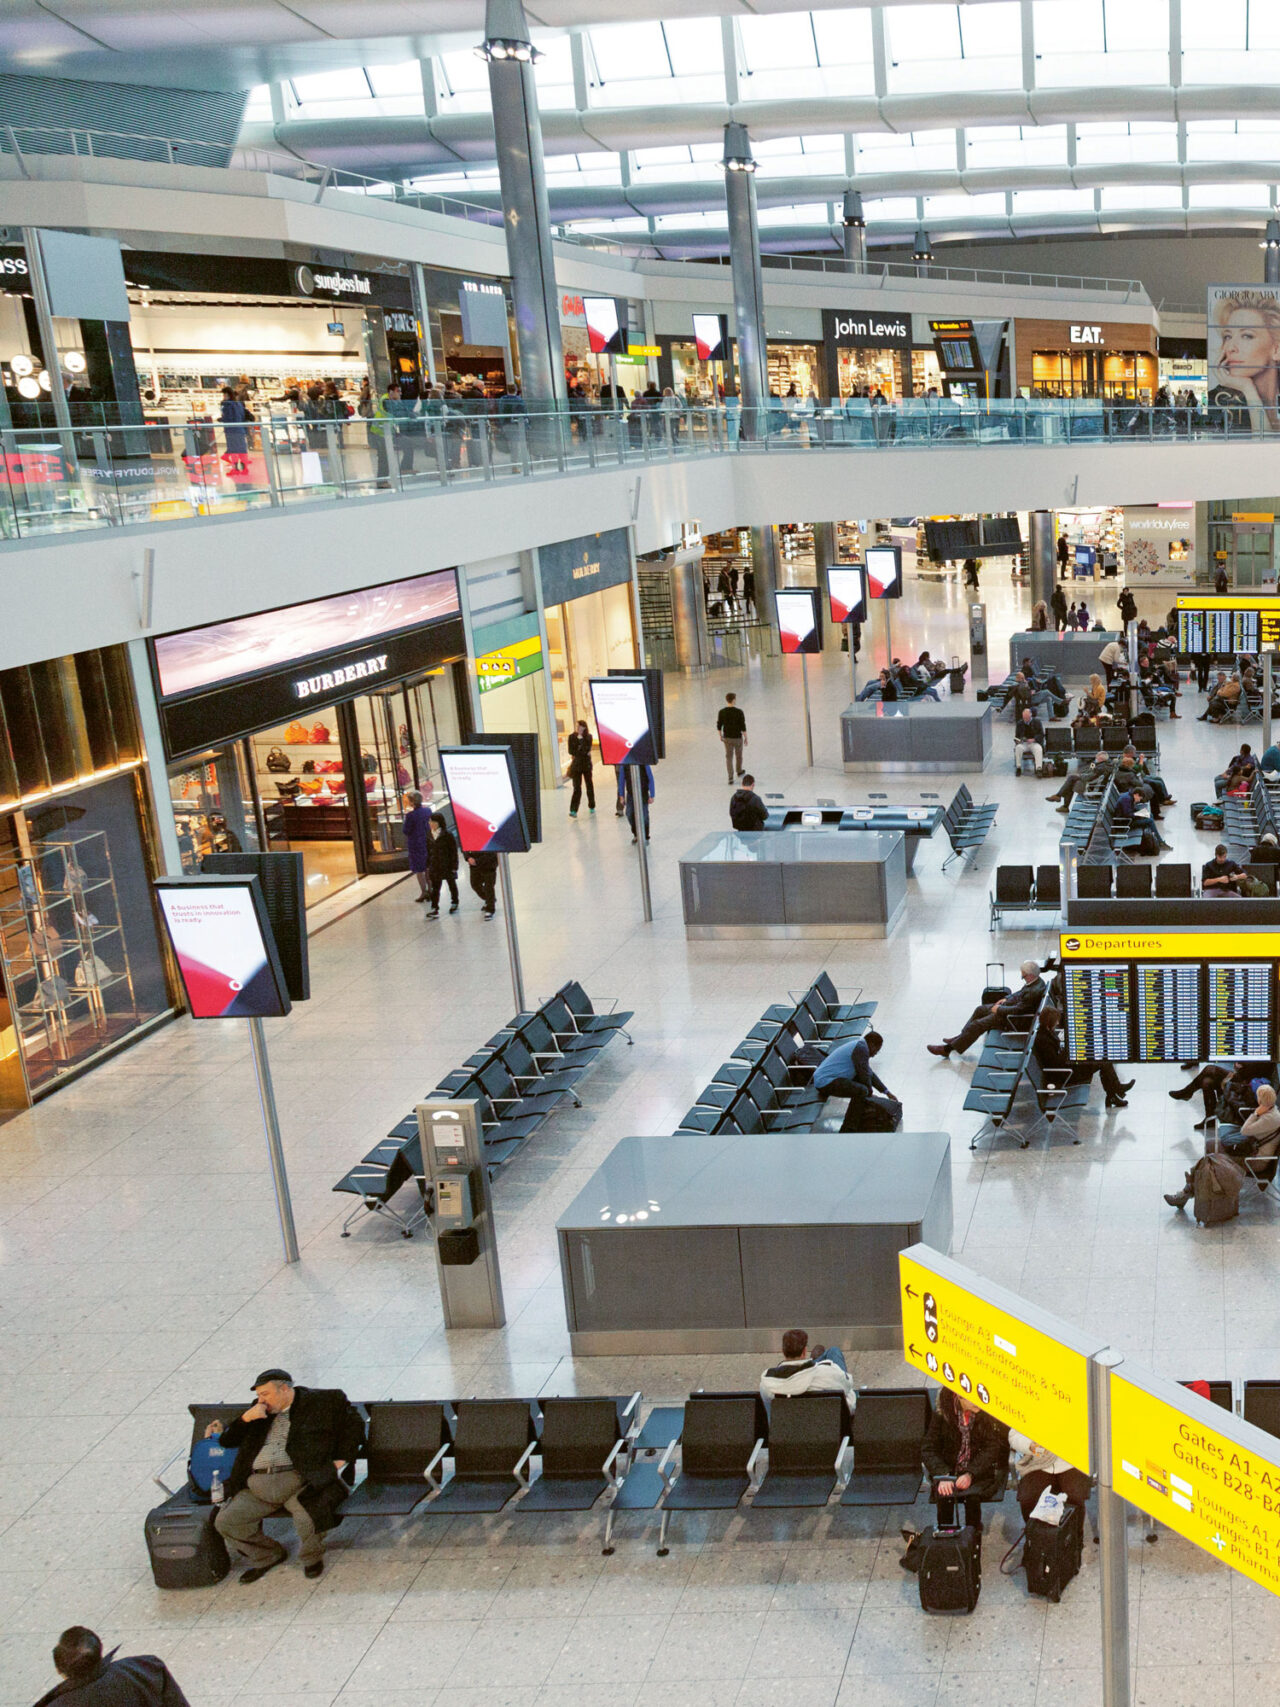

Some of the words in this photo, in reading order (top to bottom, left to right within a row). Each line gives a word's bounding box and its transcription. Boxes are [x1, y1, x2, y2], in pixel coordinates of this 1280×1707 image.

[313, 271, 355, 295] sunglass
[355, 274, 372, 295] hut
[1214, 290, 1255, 301] GIORGIO
[834, 316, 867, 339] John
[870, 318, 907, 338] Lewis
[1070, 325, 1105, 345] EAT.
[296, 654, 388, 698] BURBERRY
[1085, 938, 1162, 950] Departures
[940, 1304, 974, 1333] Lounge
[977, 1326, 991, 1341] A3
[941, 1335, 973, 1362] Airline
[974, 1355, 1009, 1383] service
[1011, 1376, 1041, 1402] desks
[986, 1345, 1037, 1384] Bedrooms
[1040, 1377, 1048, 1390] &
[1051, 1383, 1071, 1404] Spa
[994, 1395, 1027, 1424] Toilets
[1173, 1442, 1218, 1481] Gates
[1178, 1423, 1224, 1462] Gates
[1197, 1489, 1249, 1532] Lounges
[1199, 1507, 1252, 1551] Lounges
